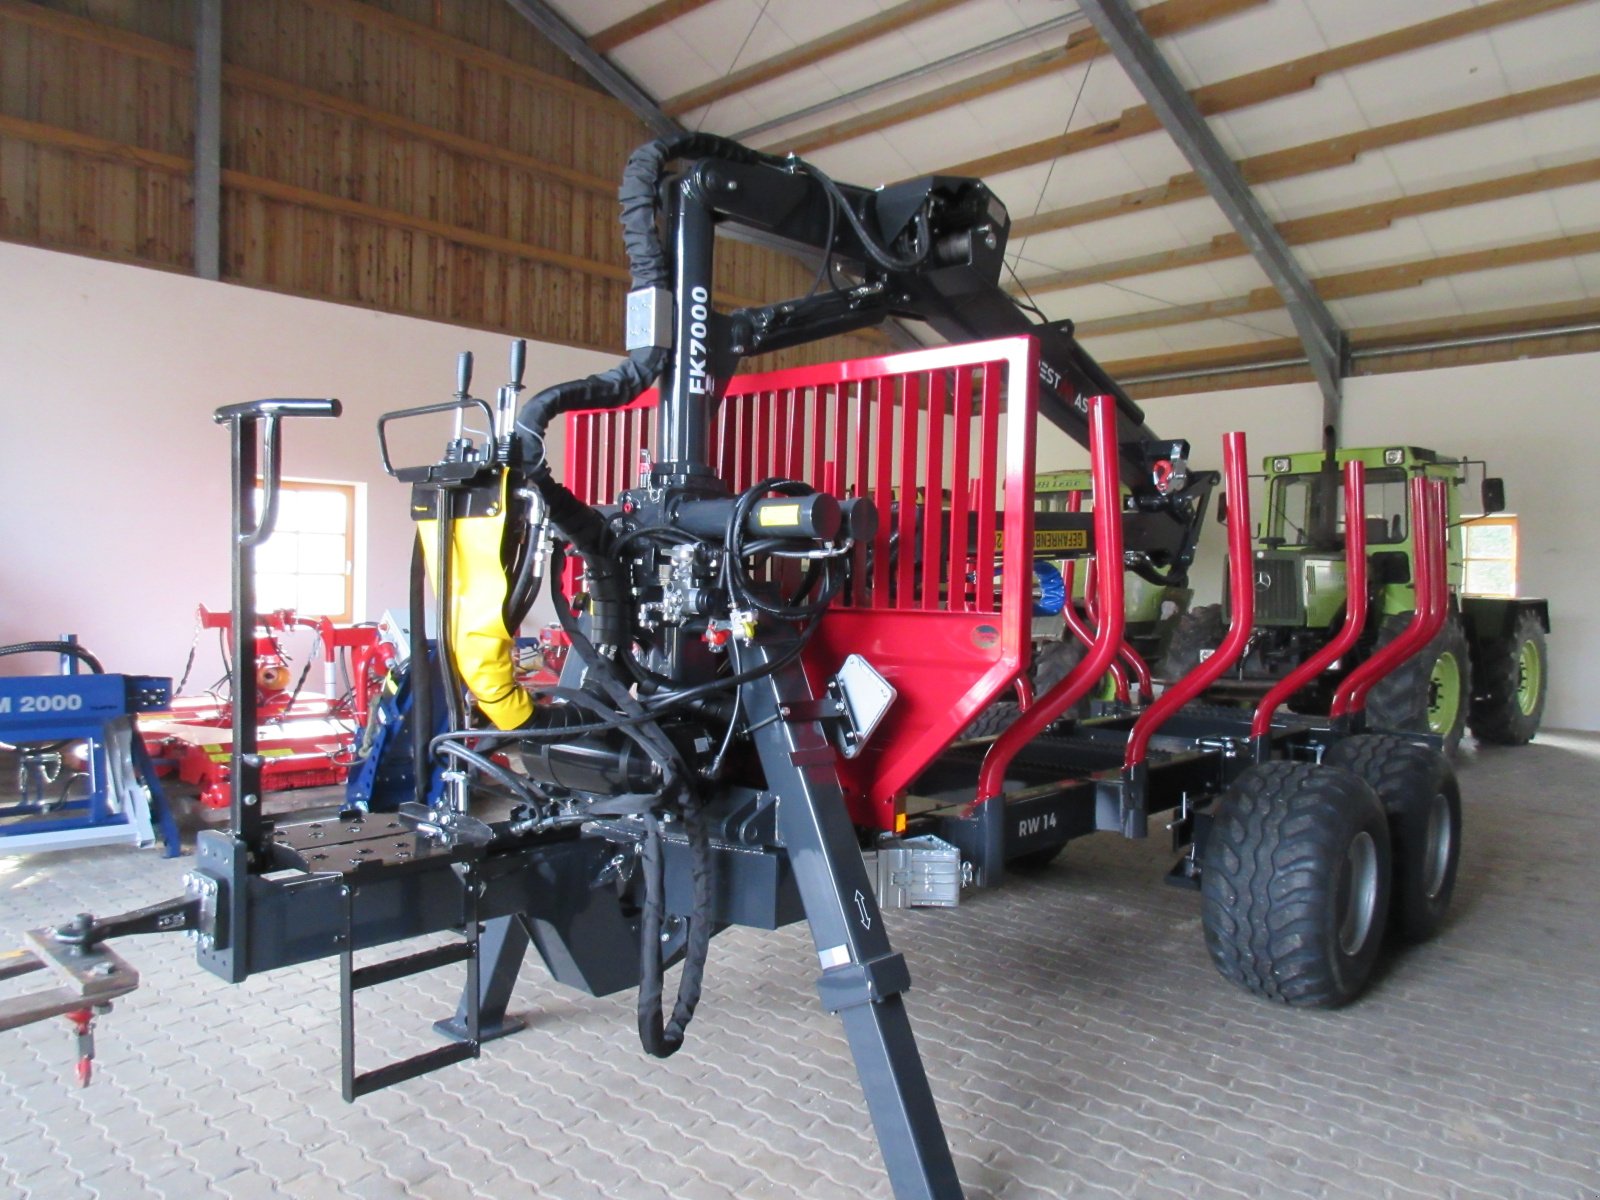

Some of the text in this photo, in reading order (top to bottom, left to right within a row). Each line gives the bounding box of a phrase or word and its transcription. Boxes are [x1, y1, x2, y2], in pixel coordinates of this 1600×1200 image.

[689, 286, 709, 395] FK7000
[1038, 360, 1062, 389] EST
[1035, 532, 1083, 548] GEFAHRENB
[19, 694, 82, 712] 2000
[1019, 812, 1057, 837] RW 14
